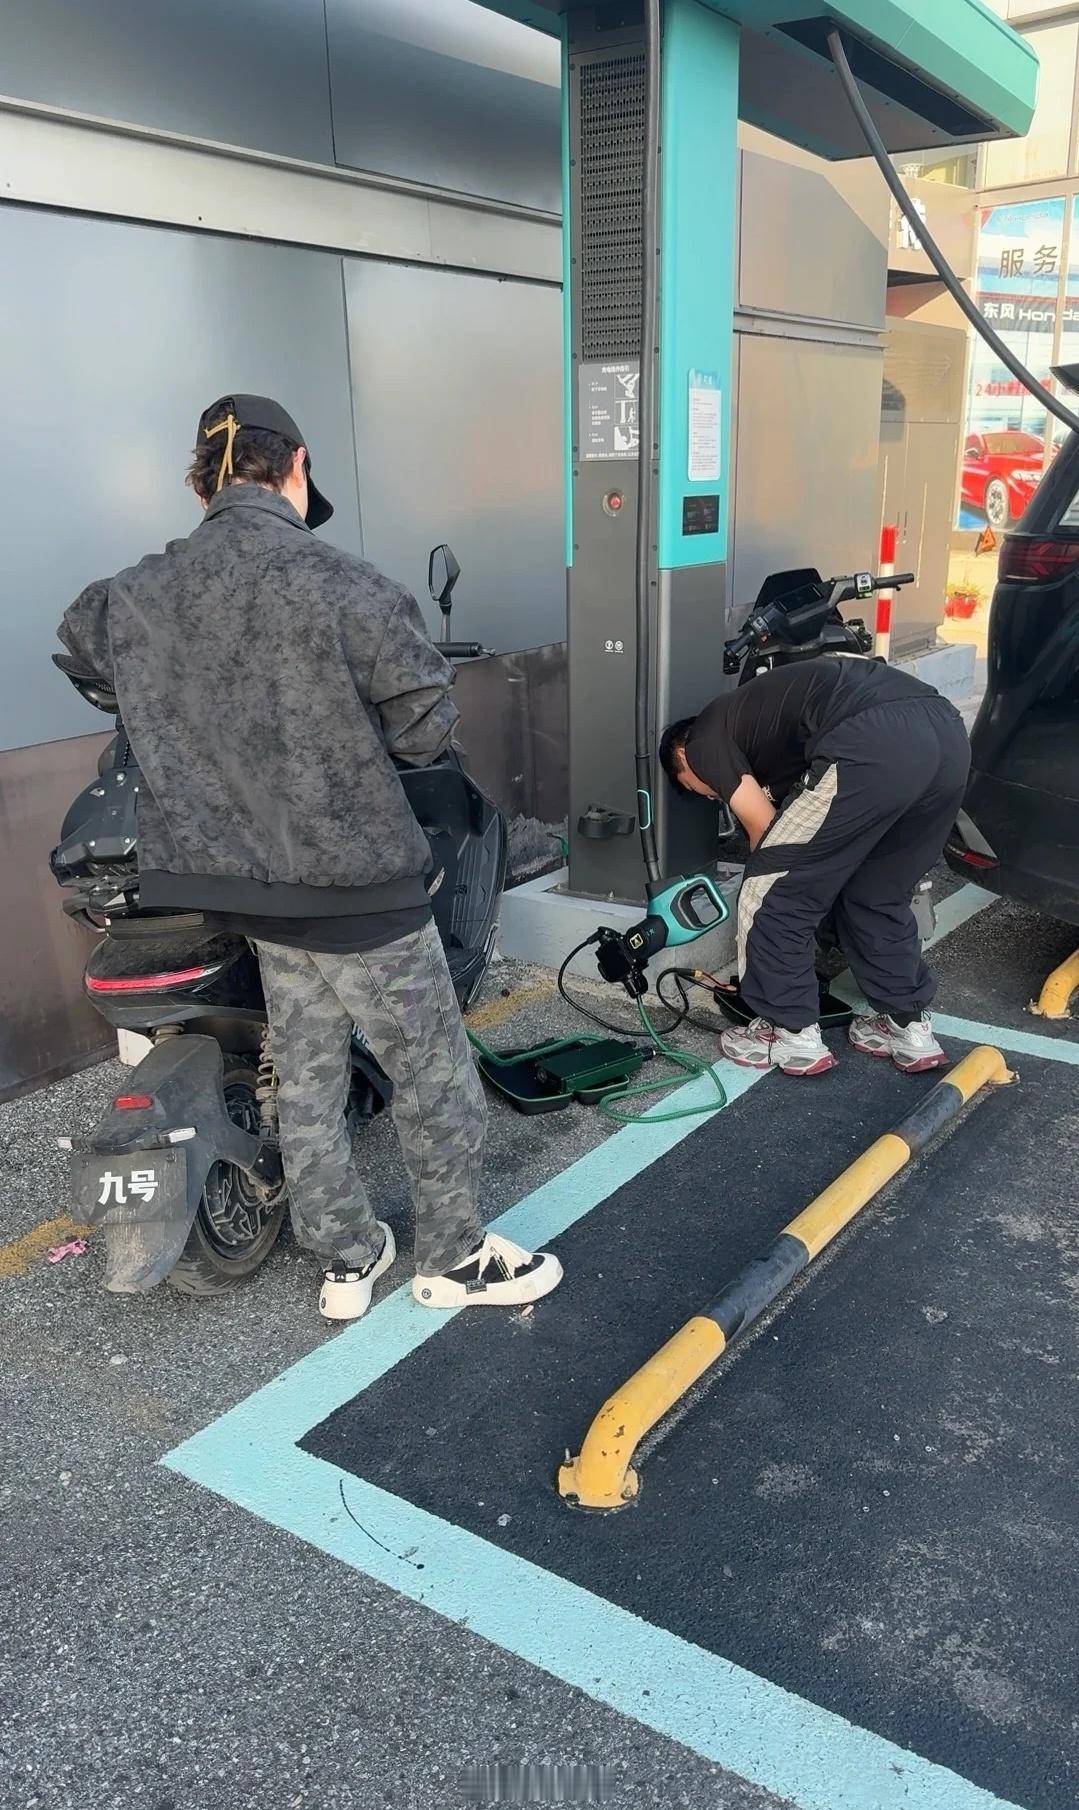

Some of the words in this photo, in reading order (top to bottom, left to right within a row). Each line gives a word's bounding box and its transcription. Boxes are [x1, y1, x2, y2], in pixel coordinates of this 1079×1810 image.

[999, 244, 1058, 279] 服务
[983, 302, 1015, 319] 东风
[98, 1169, 159, 1205] 九号
